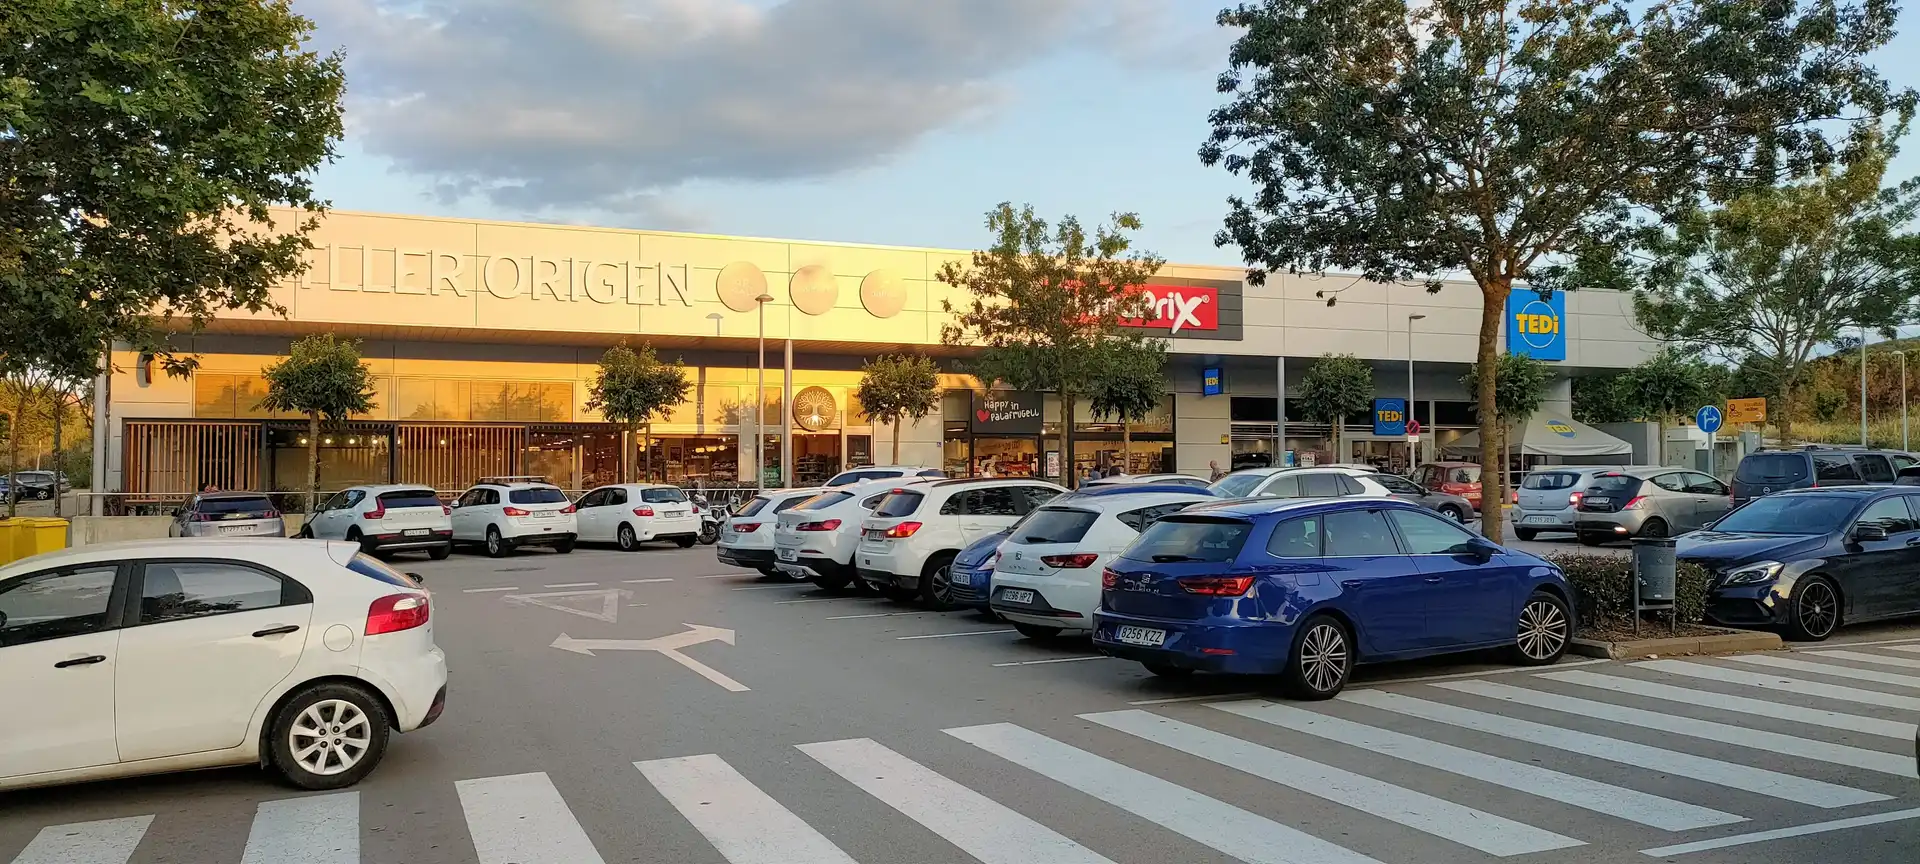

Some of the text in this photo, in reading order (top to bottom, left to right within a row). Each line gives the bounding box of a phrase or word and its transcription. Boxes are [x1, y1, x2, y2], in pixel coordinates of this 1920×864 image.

[483, 255, 693, 307] ORIGEN
[1515, 313, 1559, 335] TEDi
[1204, 376, 1219, 386] TEDi
[984, 400, 1019, 412] Happy in
[1377, 410, 1403, 422] TEDi
[1121, 627, 1163, 643] 8256 KZZ
